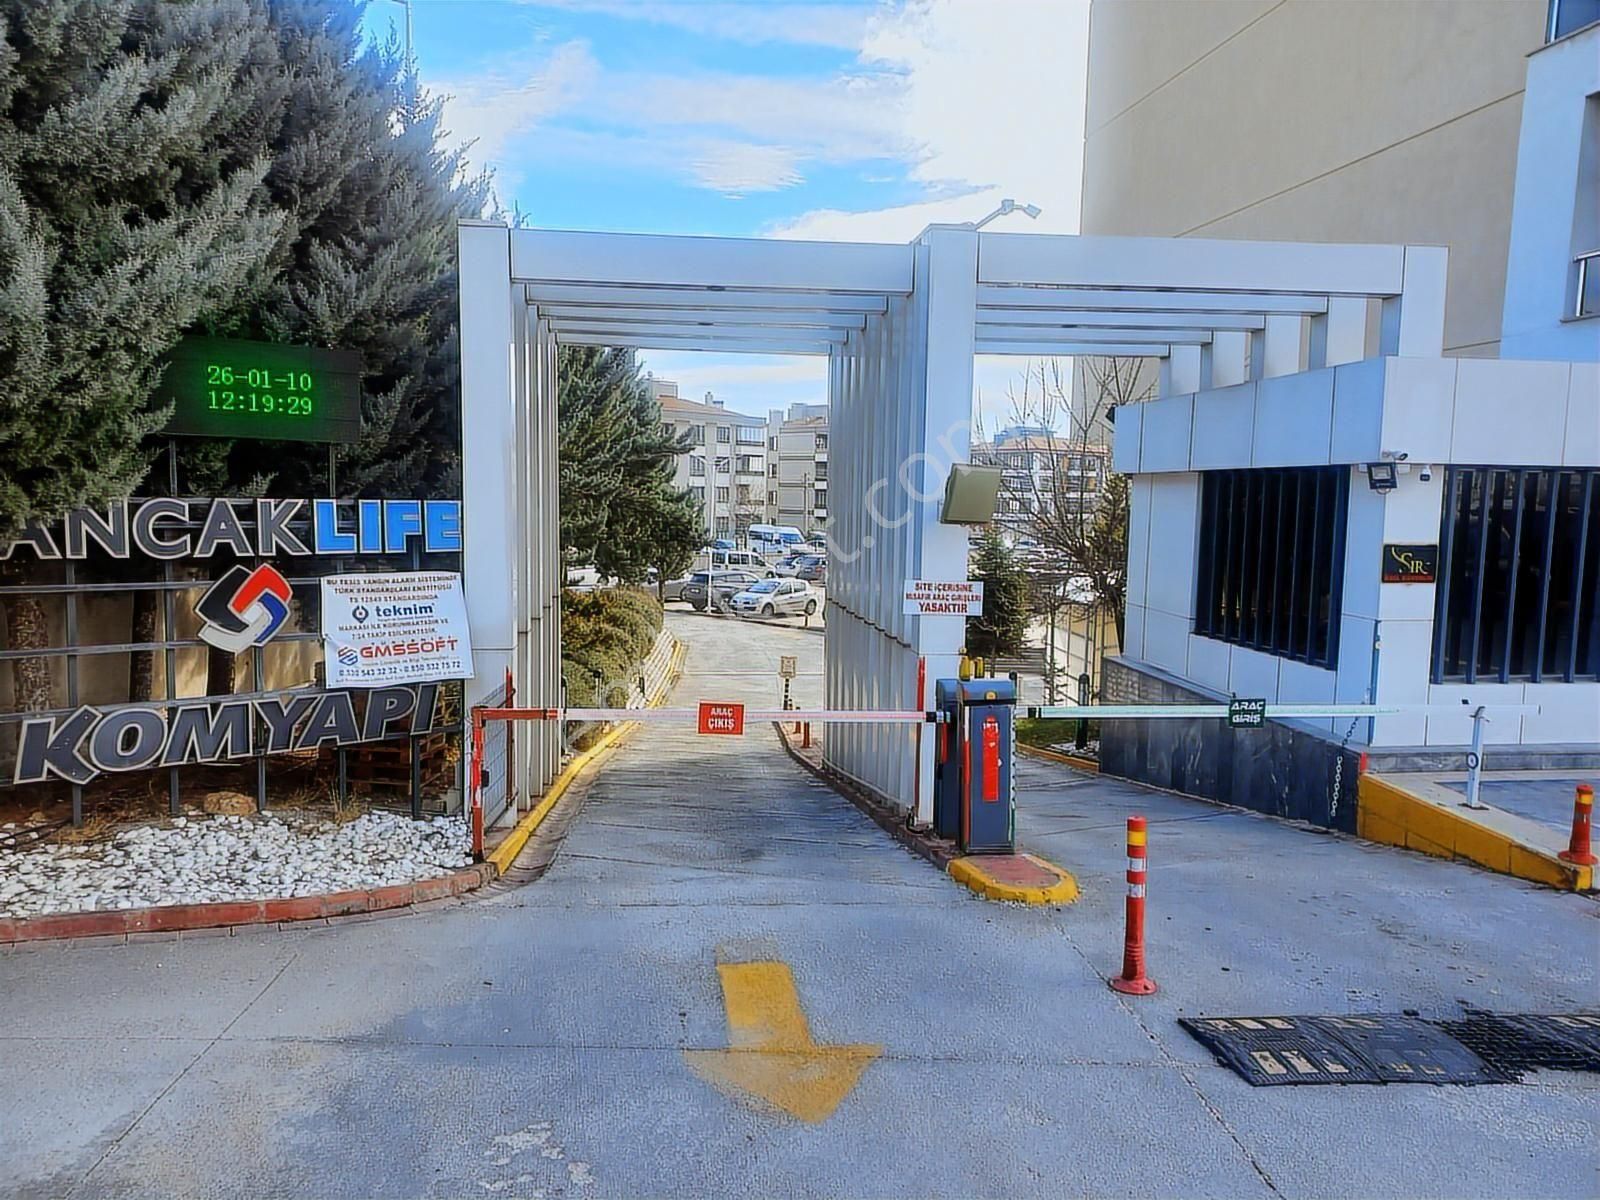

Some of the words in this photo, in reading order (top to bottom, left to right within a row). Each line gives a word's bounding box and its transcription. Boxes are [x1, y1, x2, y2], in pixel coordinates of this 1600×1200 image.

[207, 365, 312, 391] 26-01-10
[208, 391, 312, 415] 12:19:29
[375, 603, 433, 617] teknim
[918, 602, 968, 613] YASAKTIR
[361, 639, 458, 658] GMSSOFT
[710, 707, 733, 718] ARAÇ
[1231, 701, 1264, 712] ARAÇ
[708, 718, 735, 730] ÇIKIŞ
[14, 684, 440, 785] KOMYAPI
